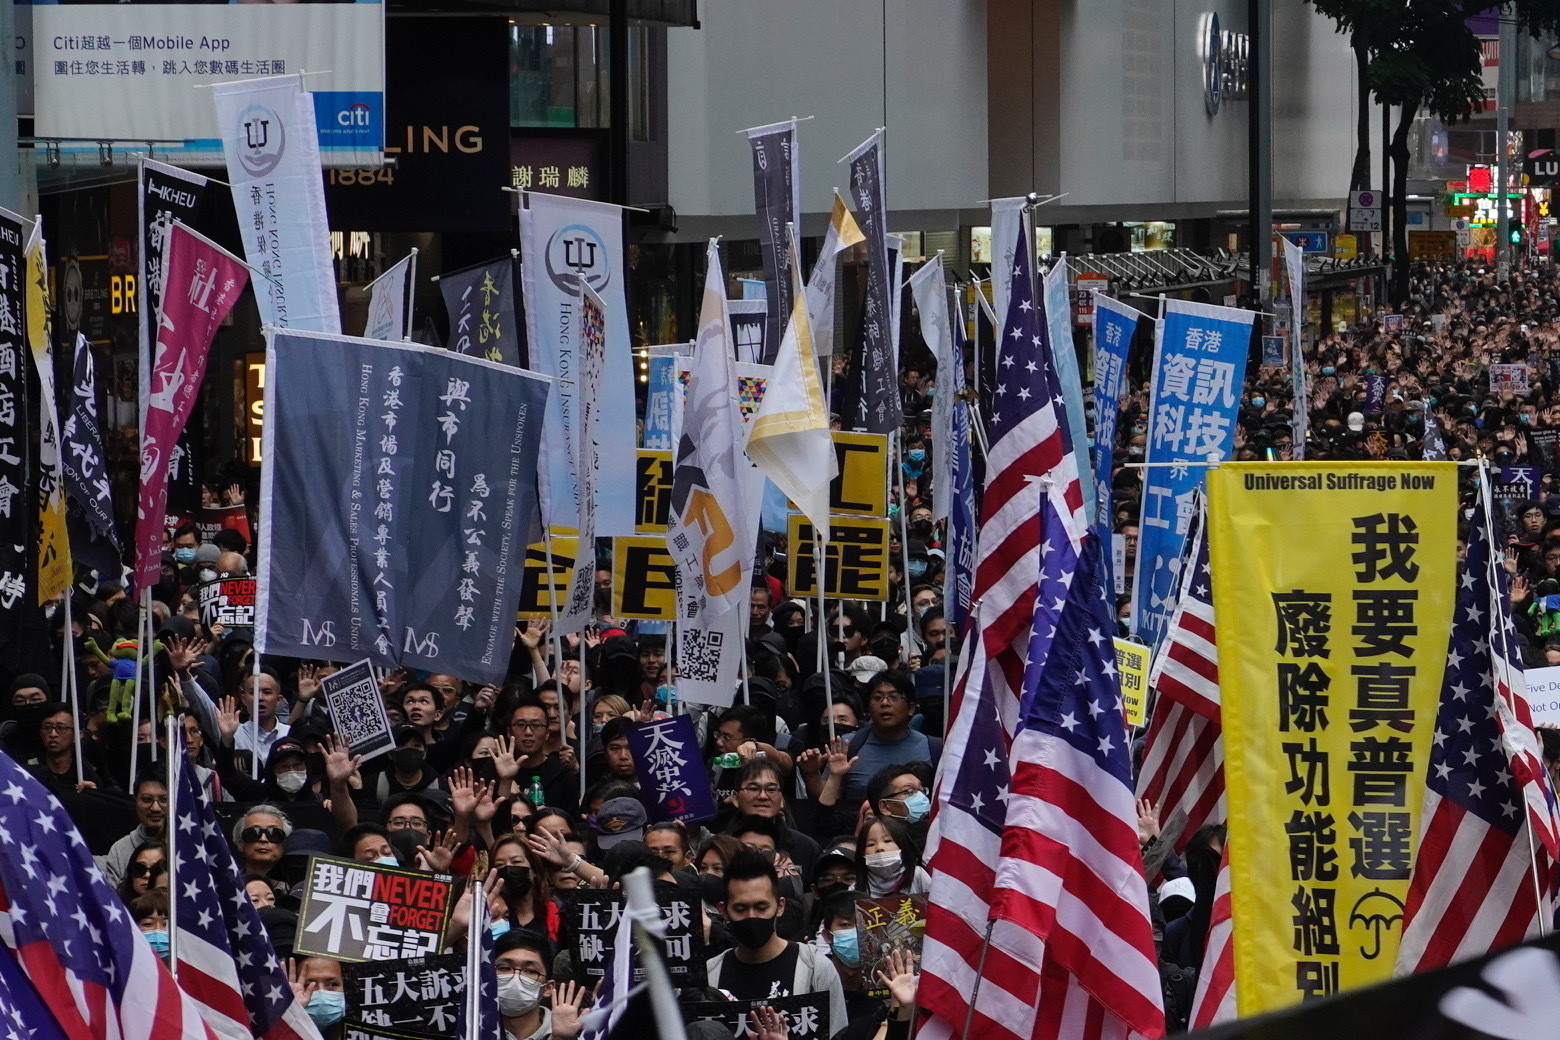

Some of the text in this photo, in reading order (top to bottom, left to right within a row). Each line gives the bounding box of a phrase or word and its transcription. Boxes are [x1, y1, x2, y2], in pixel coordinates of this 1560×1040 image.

[199, 37, 230, 52] App
[337, 103, 370, 126] citi
[511, 166, 589, 188] 謝瑞麟
[1185, 327, 1223, 352] 香港
[1160, 352, 1236, 409] 資訊
[1153, 404, 1231, 460] 科技
[1170, 458, 1188, 481] 界
[1244, 472, 1436, 493] Universal Suffrage Now
[1347, 513, 1420, 881] 我要真普選
[638, 719, 692, 804] 天滅中共
[1270, 590, 1341, 1000] 廢除功能組別
[313, 863, 446, 911] 我們 NEVER
[387, 906, 444, 931] FORGET
[577, 900, 691, 931] 五大求
[865, 898, 922, 931] 正義
[363, 924, 438, 961] 忘記
